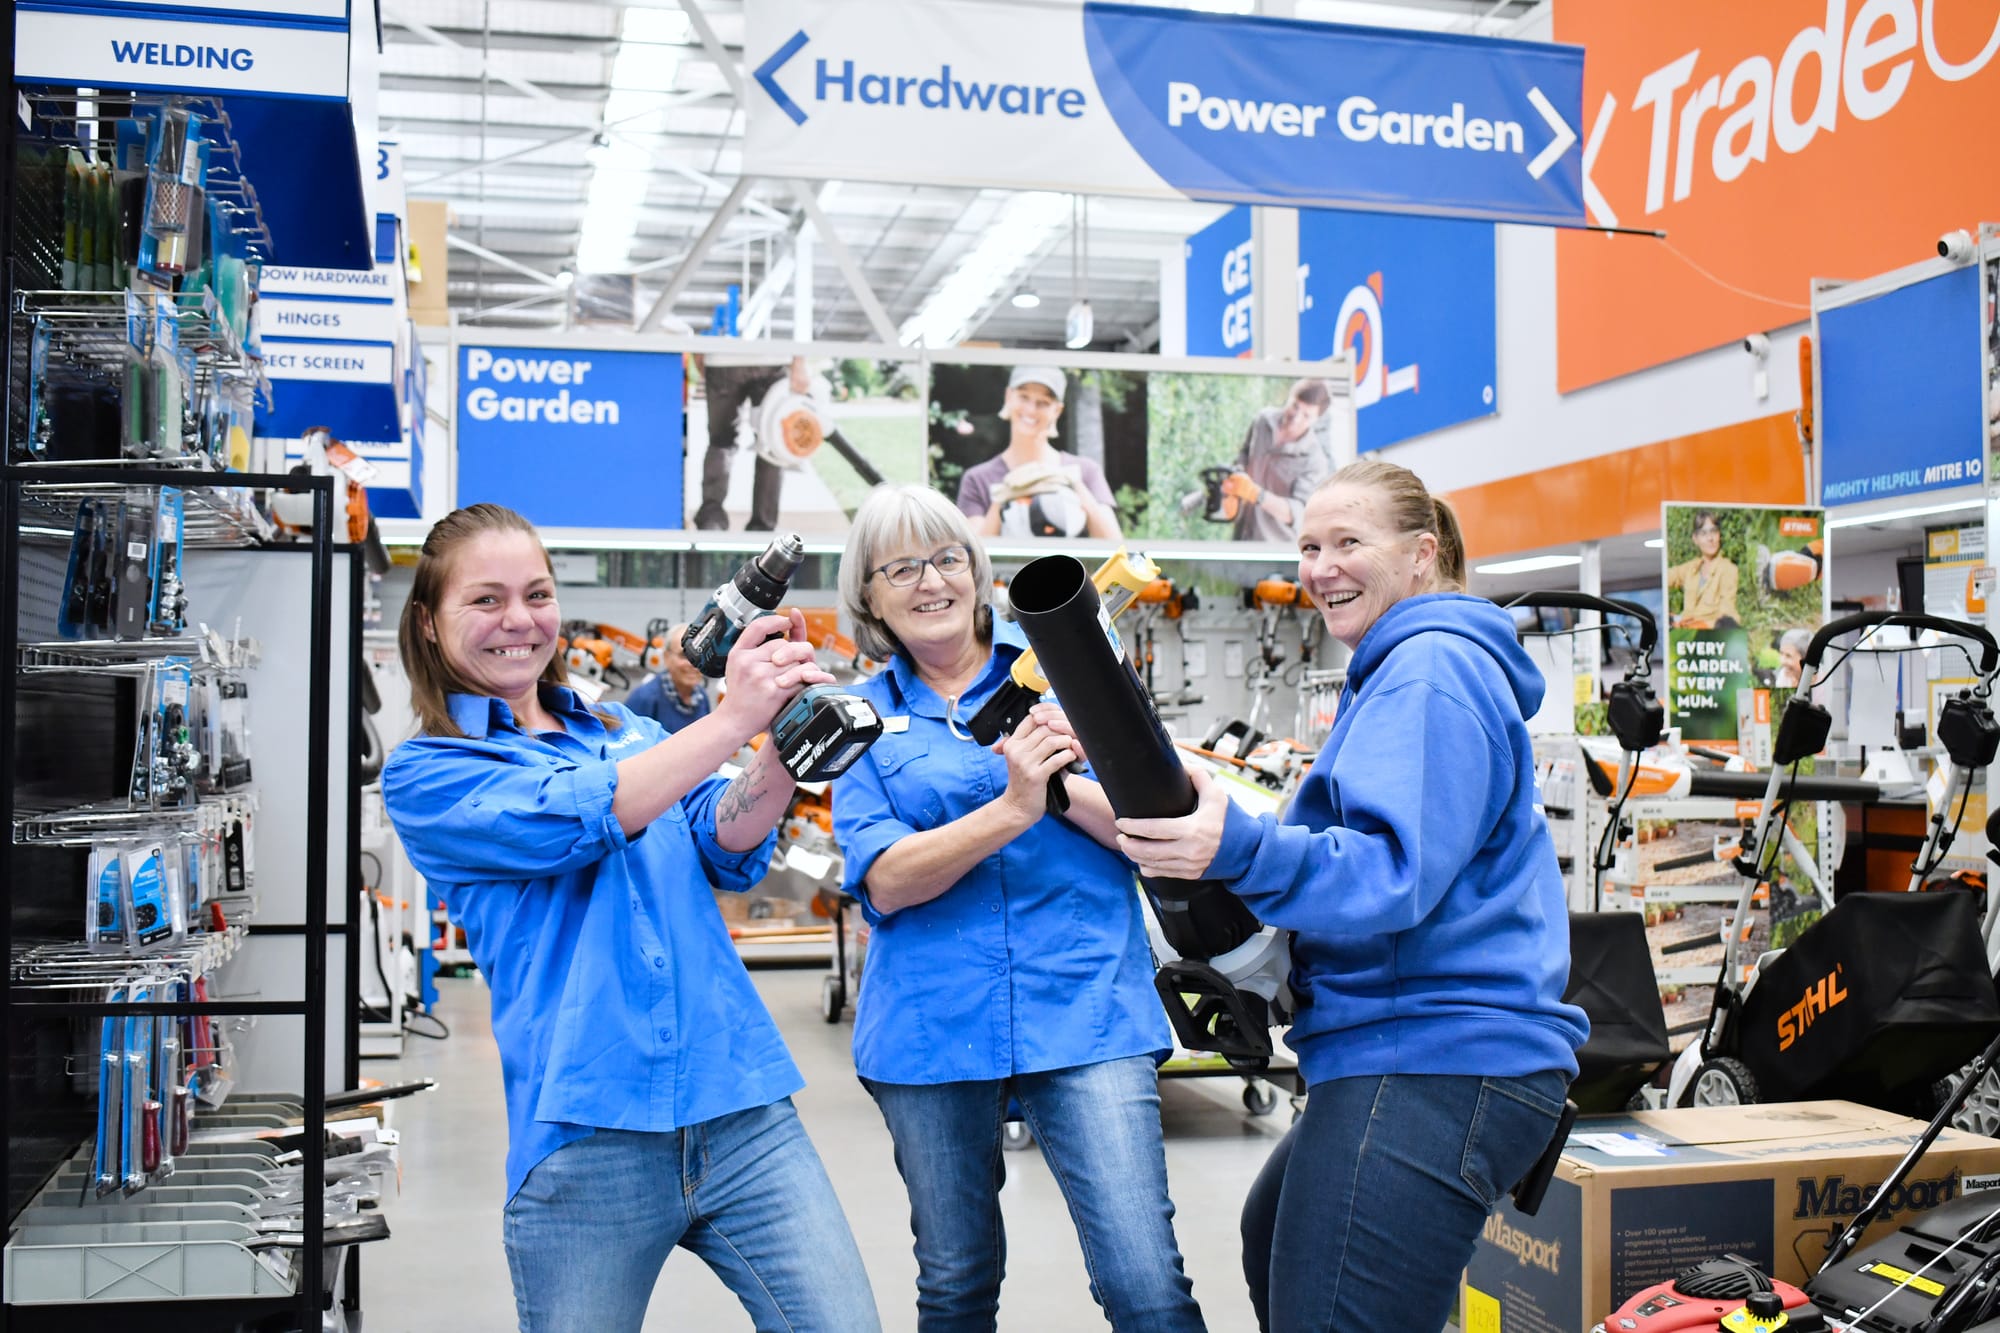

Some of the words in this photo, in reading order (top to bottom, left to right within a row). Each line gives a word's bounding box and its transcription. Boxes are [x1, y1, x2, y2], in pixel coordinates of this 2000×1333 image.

[111, 39, 254, 71] WELDING
[815, 58, 1086, 119] Hardware
[1168, 81, 1325, 138] Power
[1337, 96, 1524, 154] Garden
[303, 270, 388, 286] HARDWARE
[1222, 238, 1253, 296] GE
[278, 312, 341, 327] HINGES
[1222, 293, 1253, 349] GE
[303, 355, 364, 371] SCREEN
[467, 348, 592, 385] Power
[466, 387, 620, 425] Garden
[1823, 479, 1869, 500] MIGHTY
[1871, 469, 1921, 494] HELPFUL
[1923, 461, 1963, 484] MITRE
[1965, 458, 1982, 477] 10
[1677, 641, 1725, 656] EVERY
[1677, 659, 1743, 673] GARDEN.
[1677, 676, 1725, 691] EVERY
[1677, 694, 1718, 708] MUM.
[1777, 968, 1848, 1052] STIHL
[1794, 1166, 1958, 1223] Masport
[1483, 1212, 1560, 1274] Masport
[1624, 1229, 1642, 1238] Over
[1644, 1228, 1656, 1236] 100
[1658, 1228, 1677, 1237] years
[1679, 1226, 1687, 1234] of
[1624, 1237, 1667, 1248] engineering
[1668, 1235, 1706, 1245] excellence
[1709, 1243, 1722, 1251] and
[1724, 1241, 1739, 1251] truly
